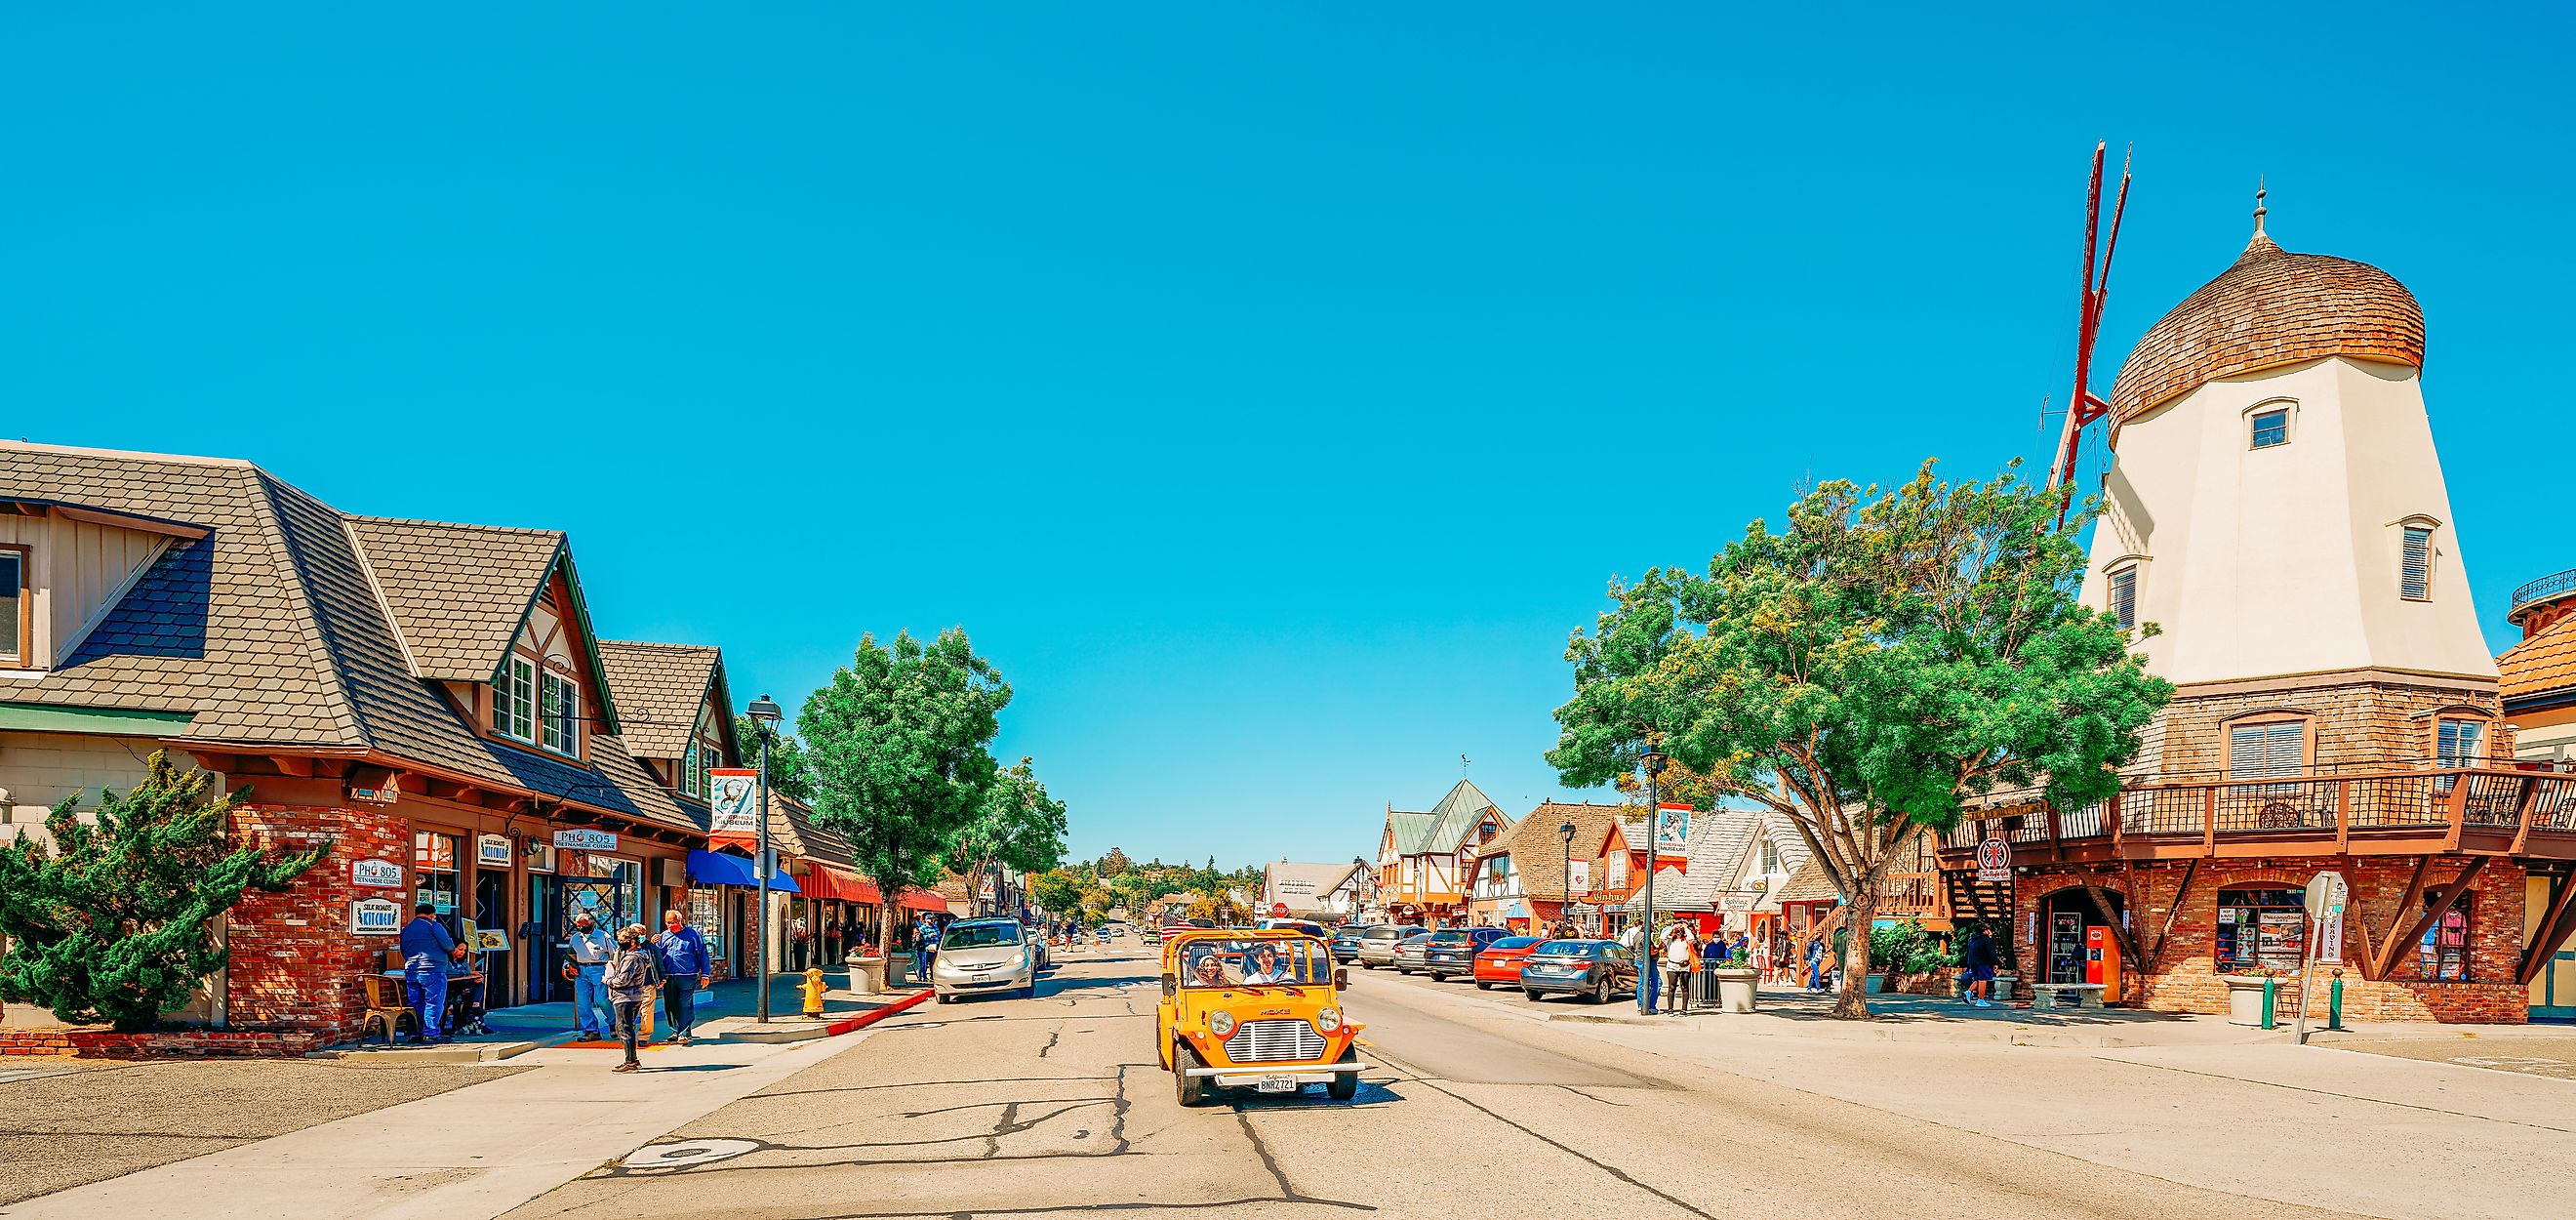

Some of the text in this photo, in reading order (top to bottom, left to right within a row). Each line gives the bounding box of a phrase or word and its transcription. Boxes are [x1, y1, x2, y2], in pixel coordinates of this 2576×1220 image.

[588, 834, 610, 843] 805
[381, 868, 397, 877] 805
[2327, 919, 2336, 957] RAVING
